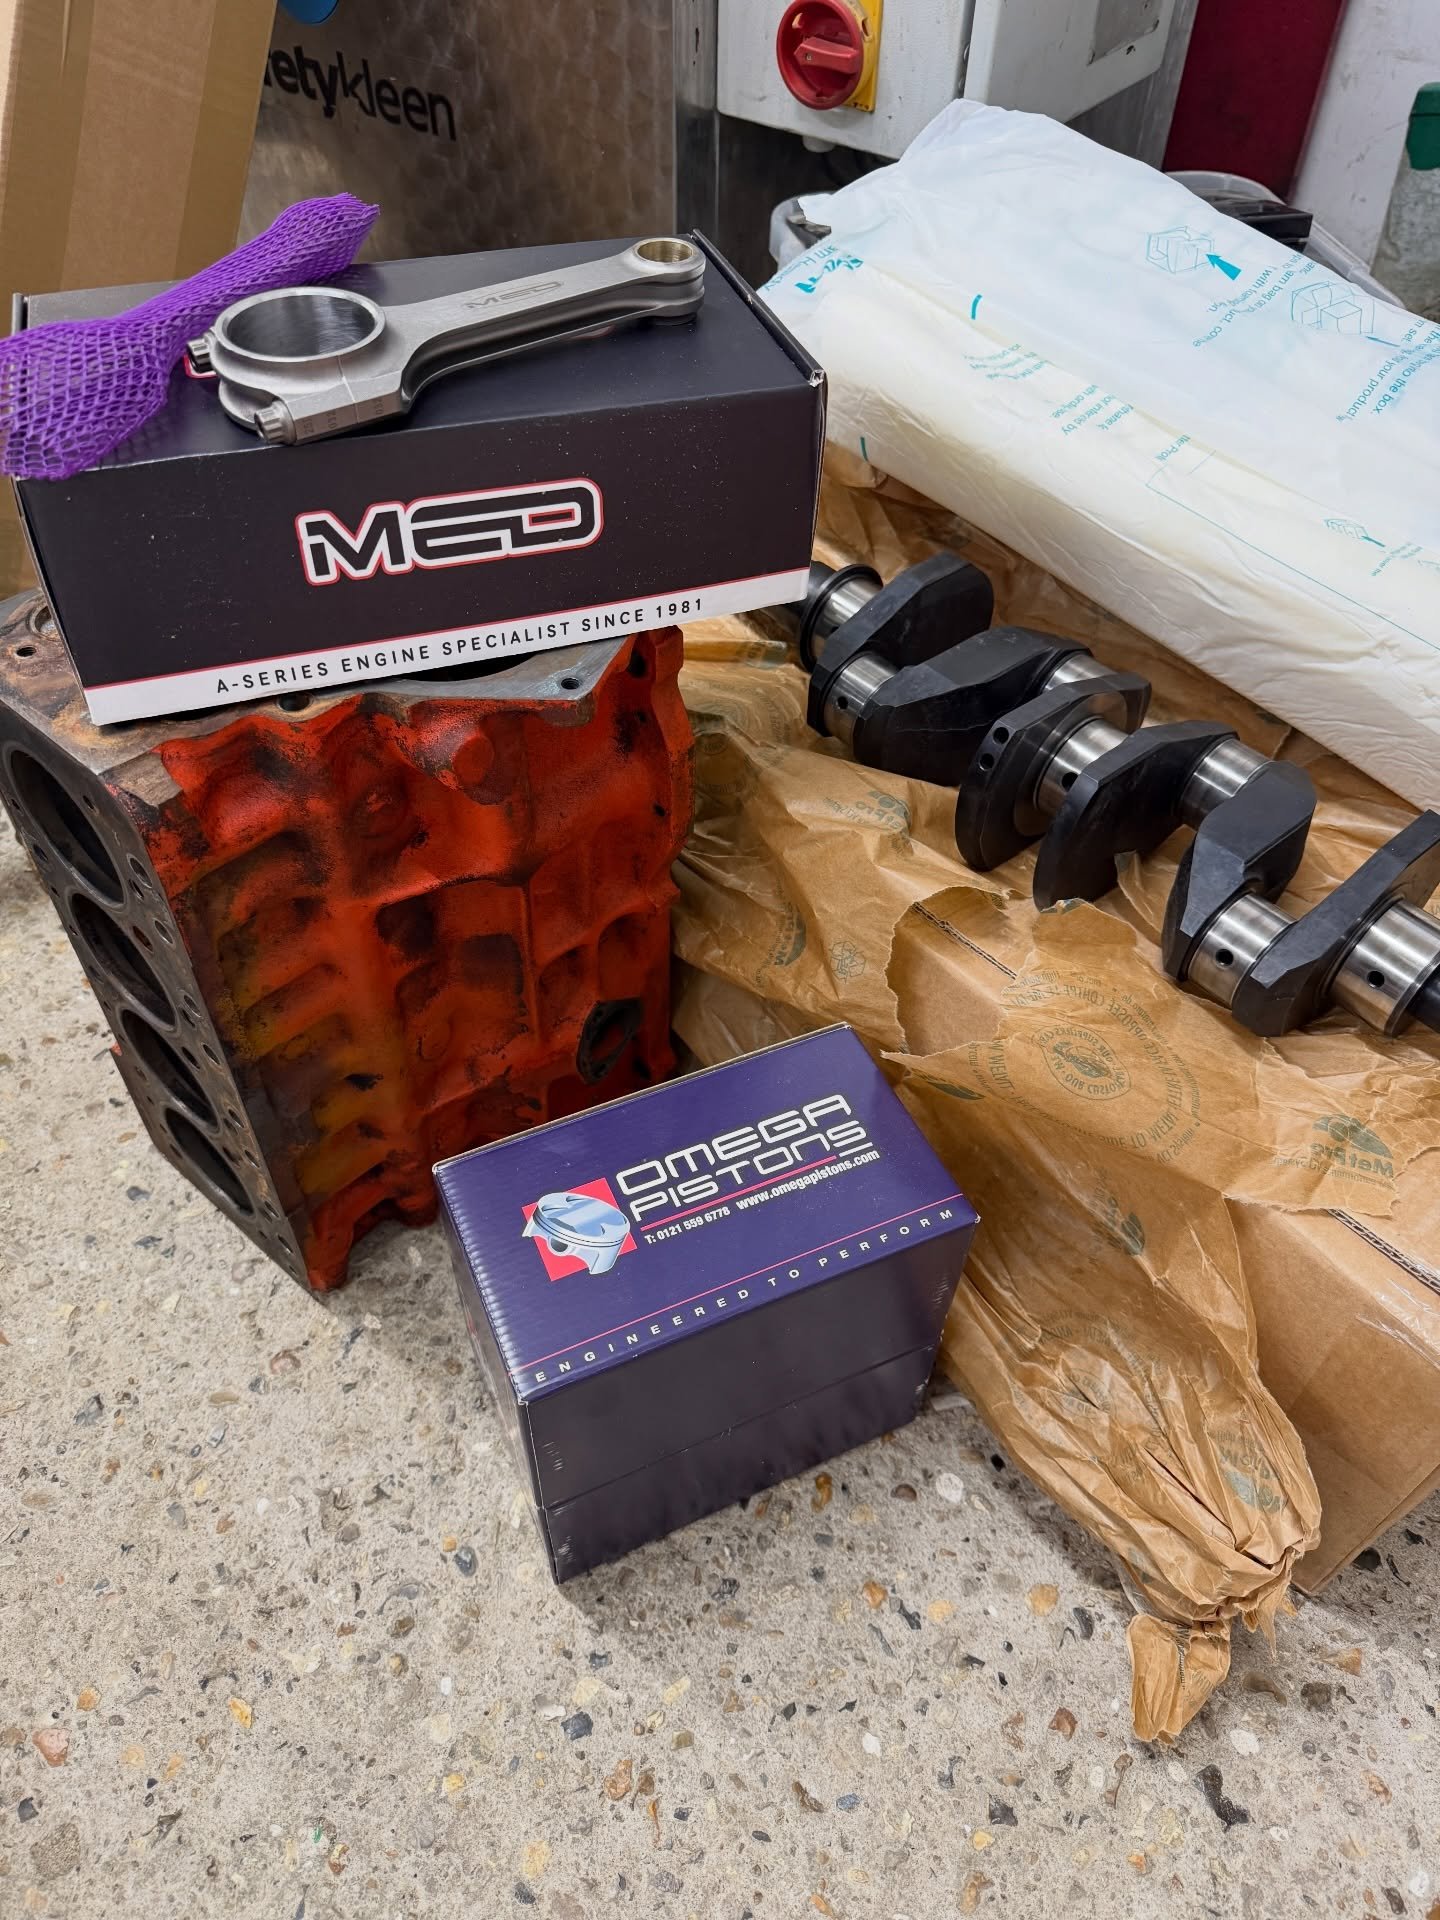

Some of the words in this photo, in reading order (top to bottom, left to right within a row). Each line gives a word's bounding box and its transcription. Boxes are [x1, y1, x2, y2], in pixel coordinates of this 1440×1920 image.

[1388, 378, 1407, 394] the
[295, 478, 603, 585] MED
[217, 662, 329, 693] A-SERIES
[341, 645, 430, 673] ENGINE
[442, 622, 570, 656] SPECIALIST
[581, 608, 644, 632] SINCE
[656, 598, 702, 618] 1981
[615, 1093, 852, 1196] OMEGA
[643, 1234, 657, 1245] T:
[656, 1222, 683, 1241] 0121
[682, 1215, 704, 1233] 559
[704, 1205, 731, 1225] 6778
[736, 1148, 880, 1211] www.omegapistons.com
[535, 1289, 749, 1383] ENGINEERED
[767, 1268, 800, 1287] TO
[818, 1209, 953, 1267] PERFORM
